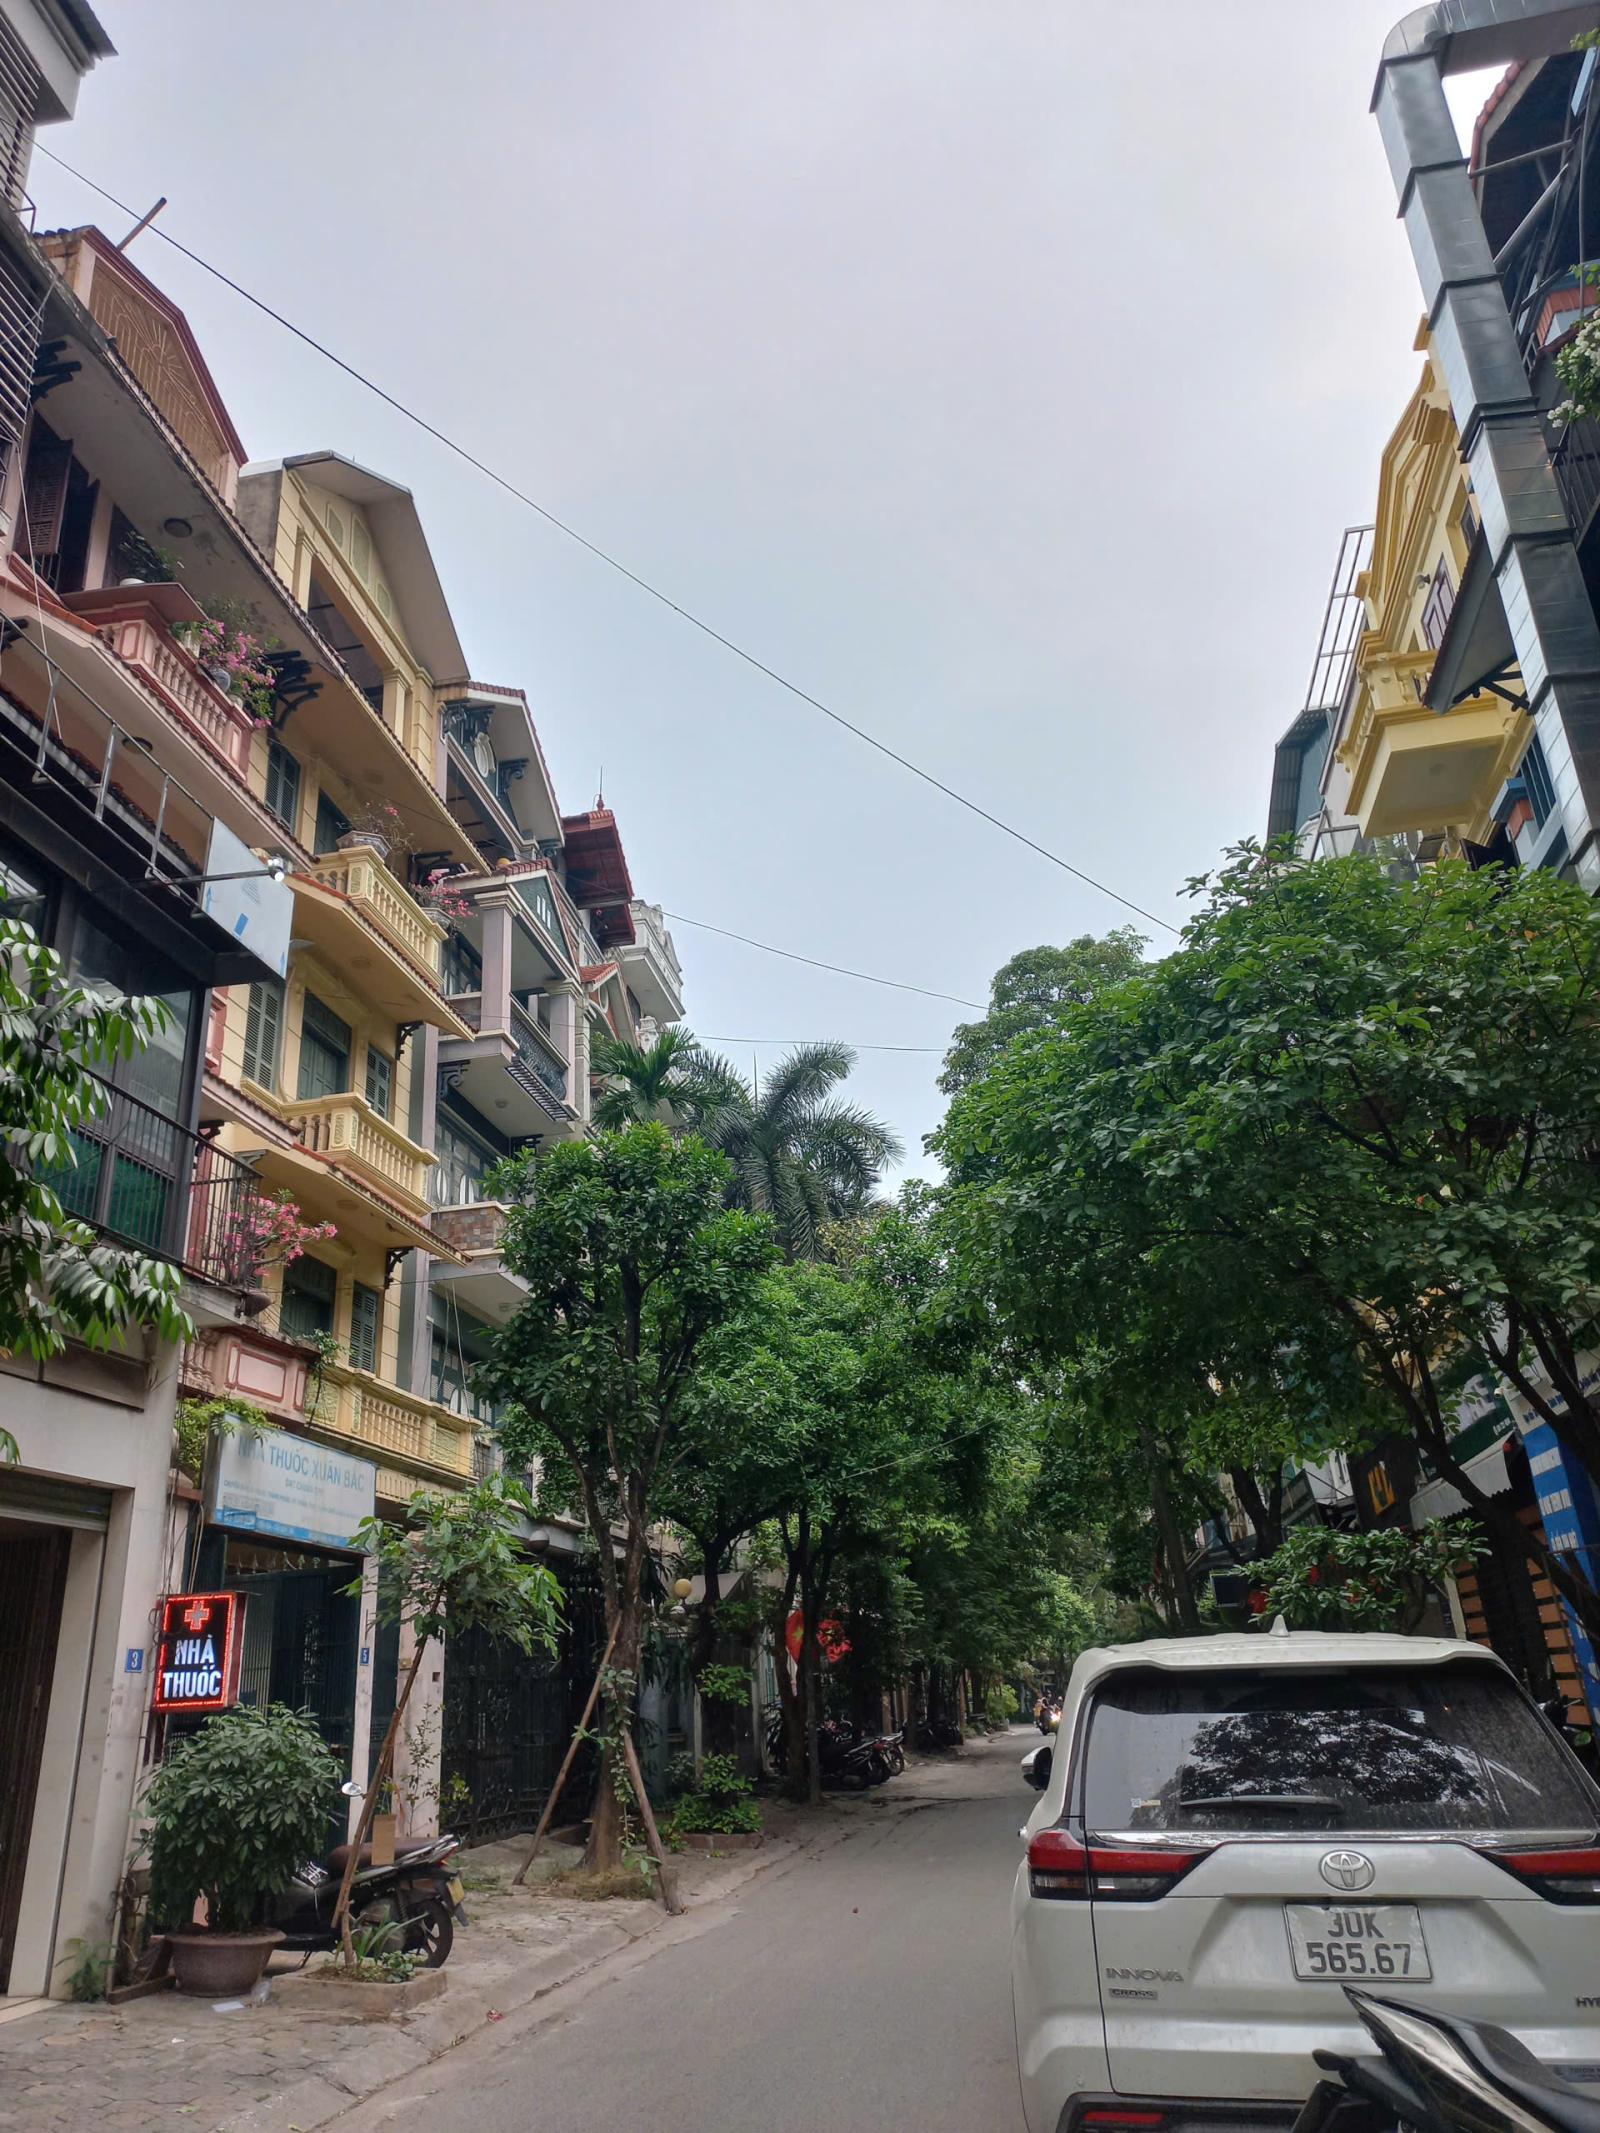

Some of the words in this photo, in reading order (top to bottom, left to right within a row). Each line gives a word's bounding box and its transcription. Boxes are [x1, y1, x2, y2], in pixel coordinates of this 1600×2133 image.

[131, 1651, 139, 1669] 3
[174, 1634, 215, 1665] NHÀ
[363, 1649, 368, 1662] 5
[163, 1664, 222, 1699] THUỐC
[1327, 1911, 1384, 1938] 30K
[1306, 1942, 1411, 1974] 565.67
[1106, 1967, 1185, 1982] INNOVA
[1111, 1988, 1155, 1998] CROSS
